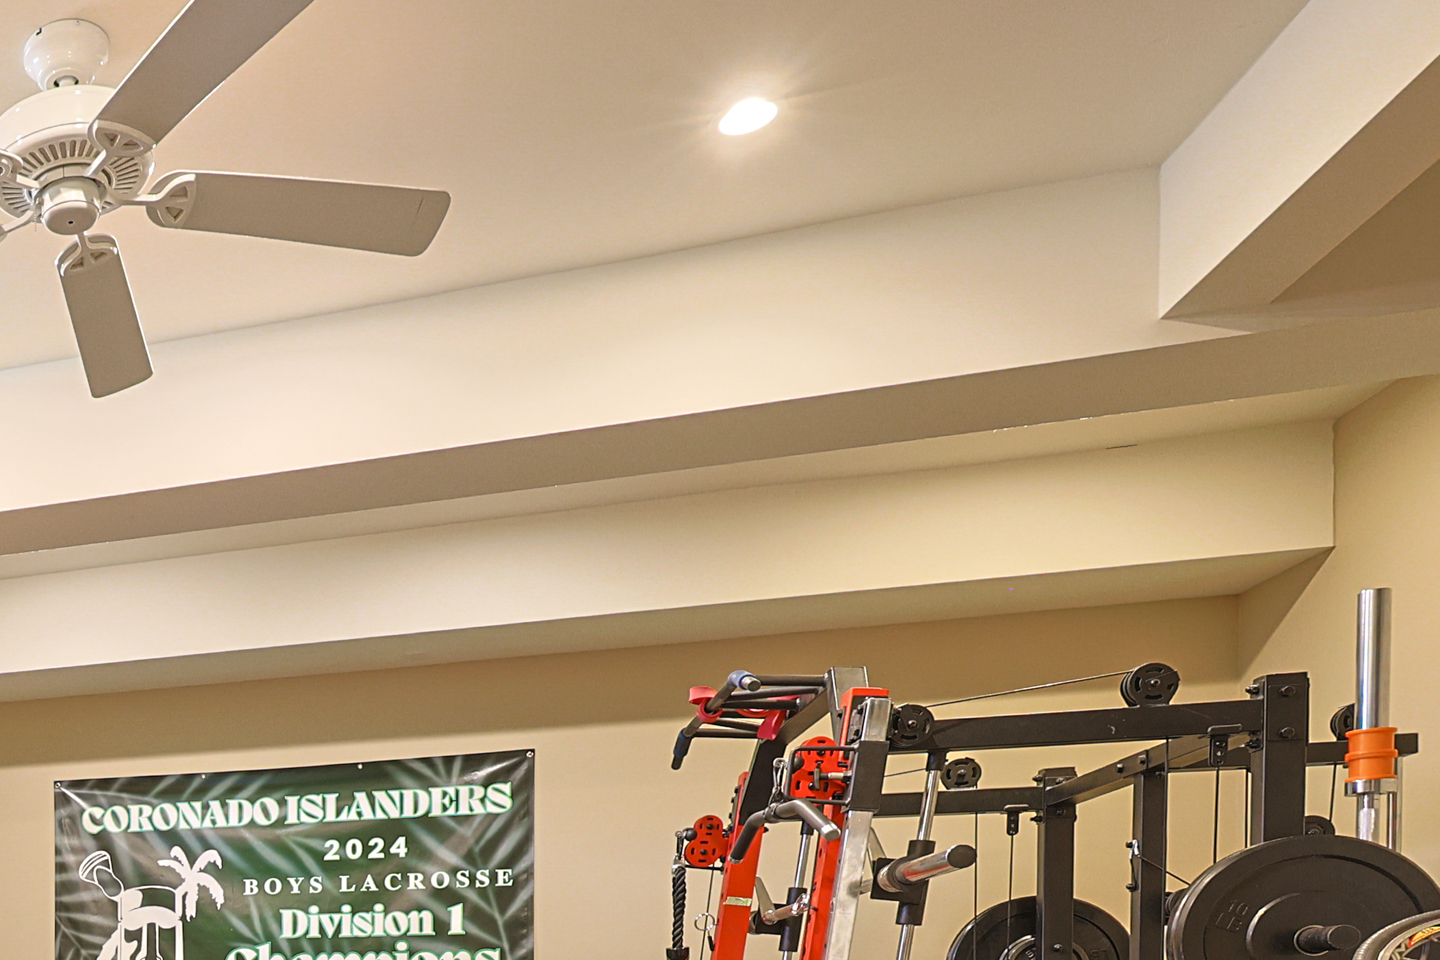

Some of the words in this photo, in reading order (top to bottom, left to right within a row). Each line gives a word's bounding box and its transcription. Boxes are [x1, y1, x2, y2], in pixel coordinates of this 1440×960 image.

[81, 796, 280, 835] CORONADO
[284, 781, 514, 825] ISLANDERS
[323, 836, 409, 861] 2024
[242, 876, 324, 896] BOYS
[338, 868, 514, 893] LACROSSE
[278, 902, 436, 939] Division
[446, 902, 466, 936] 1
